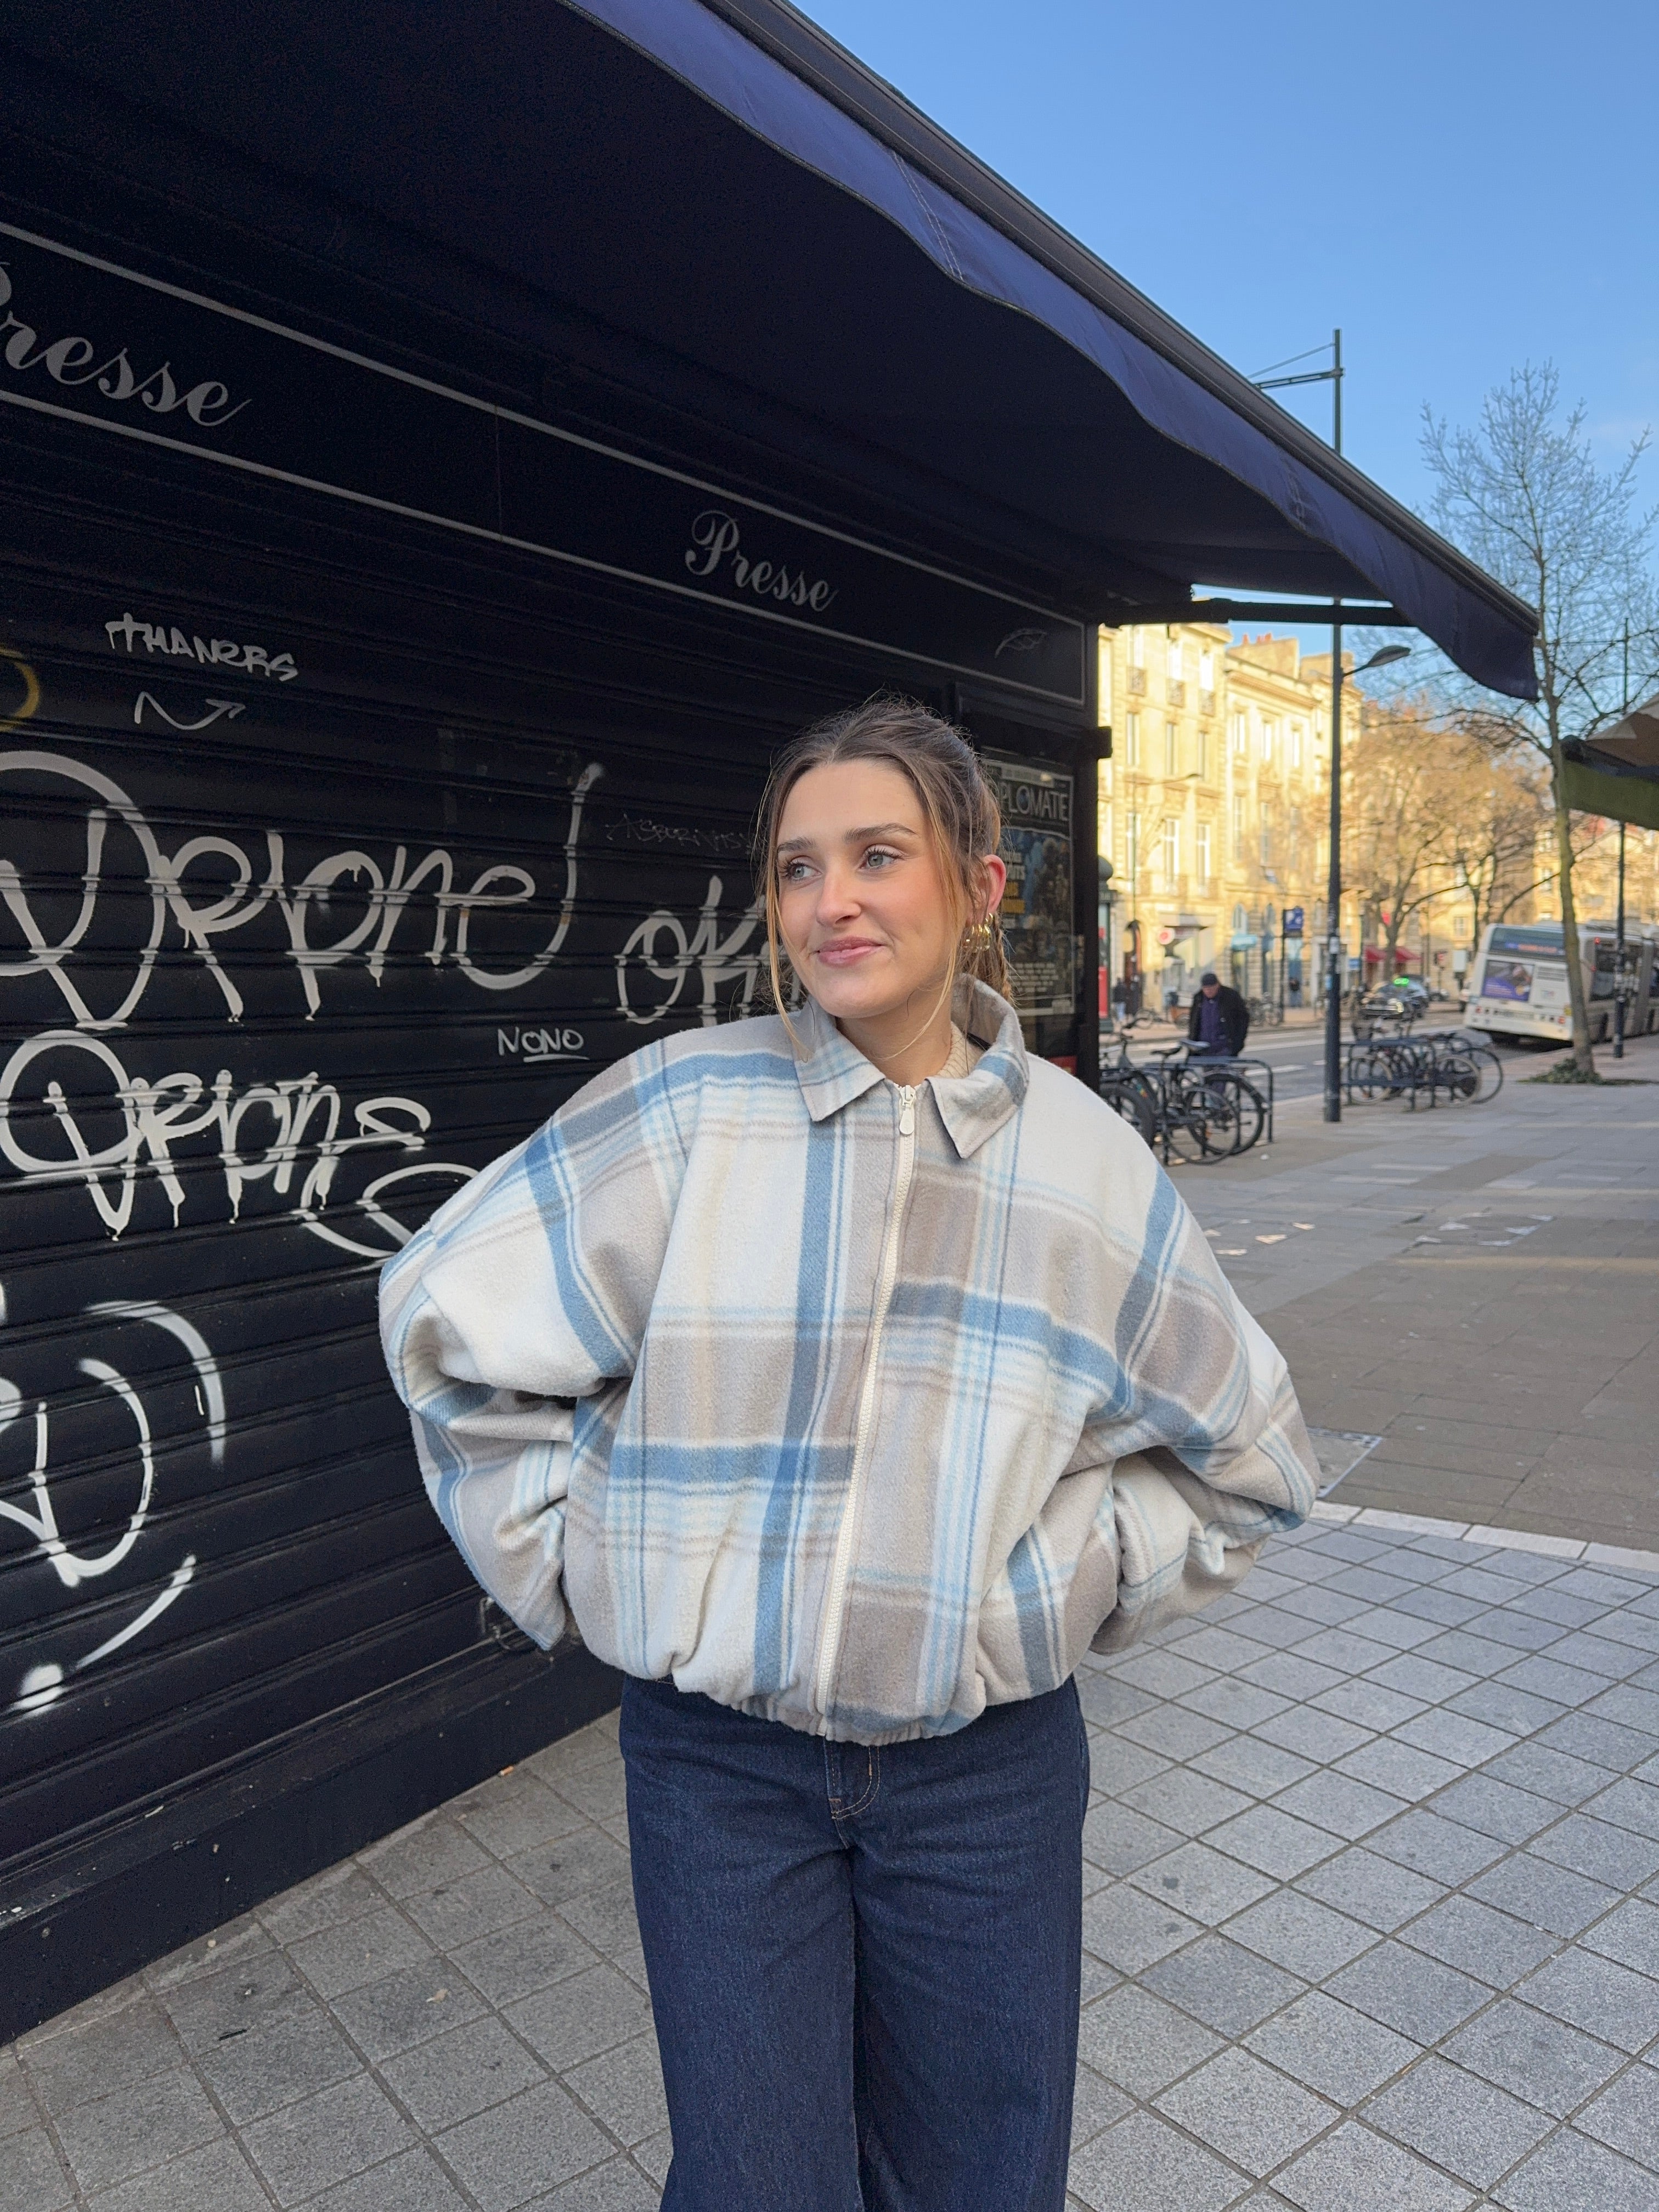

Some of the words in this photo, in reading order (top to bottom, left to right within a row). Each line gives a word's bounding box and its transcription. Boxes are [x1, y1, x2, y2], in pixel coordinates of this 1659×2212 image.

[0, 262, 252, 426] resse
[685, 510, 838, 612] Presse
[998, 781, 1069, 822] PLOMATE
[498, 1026, 584, 1056] NONO
